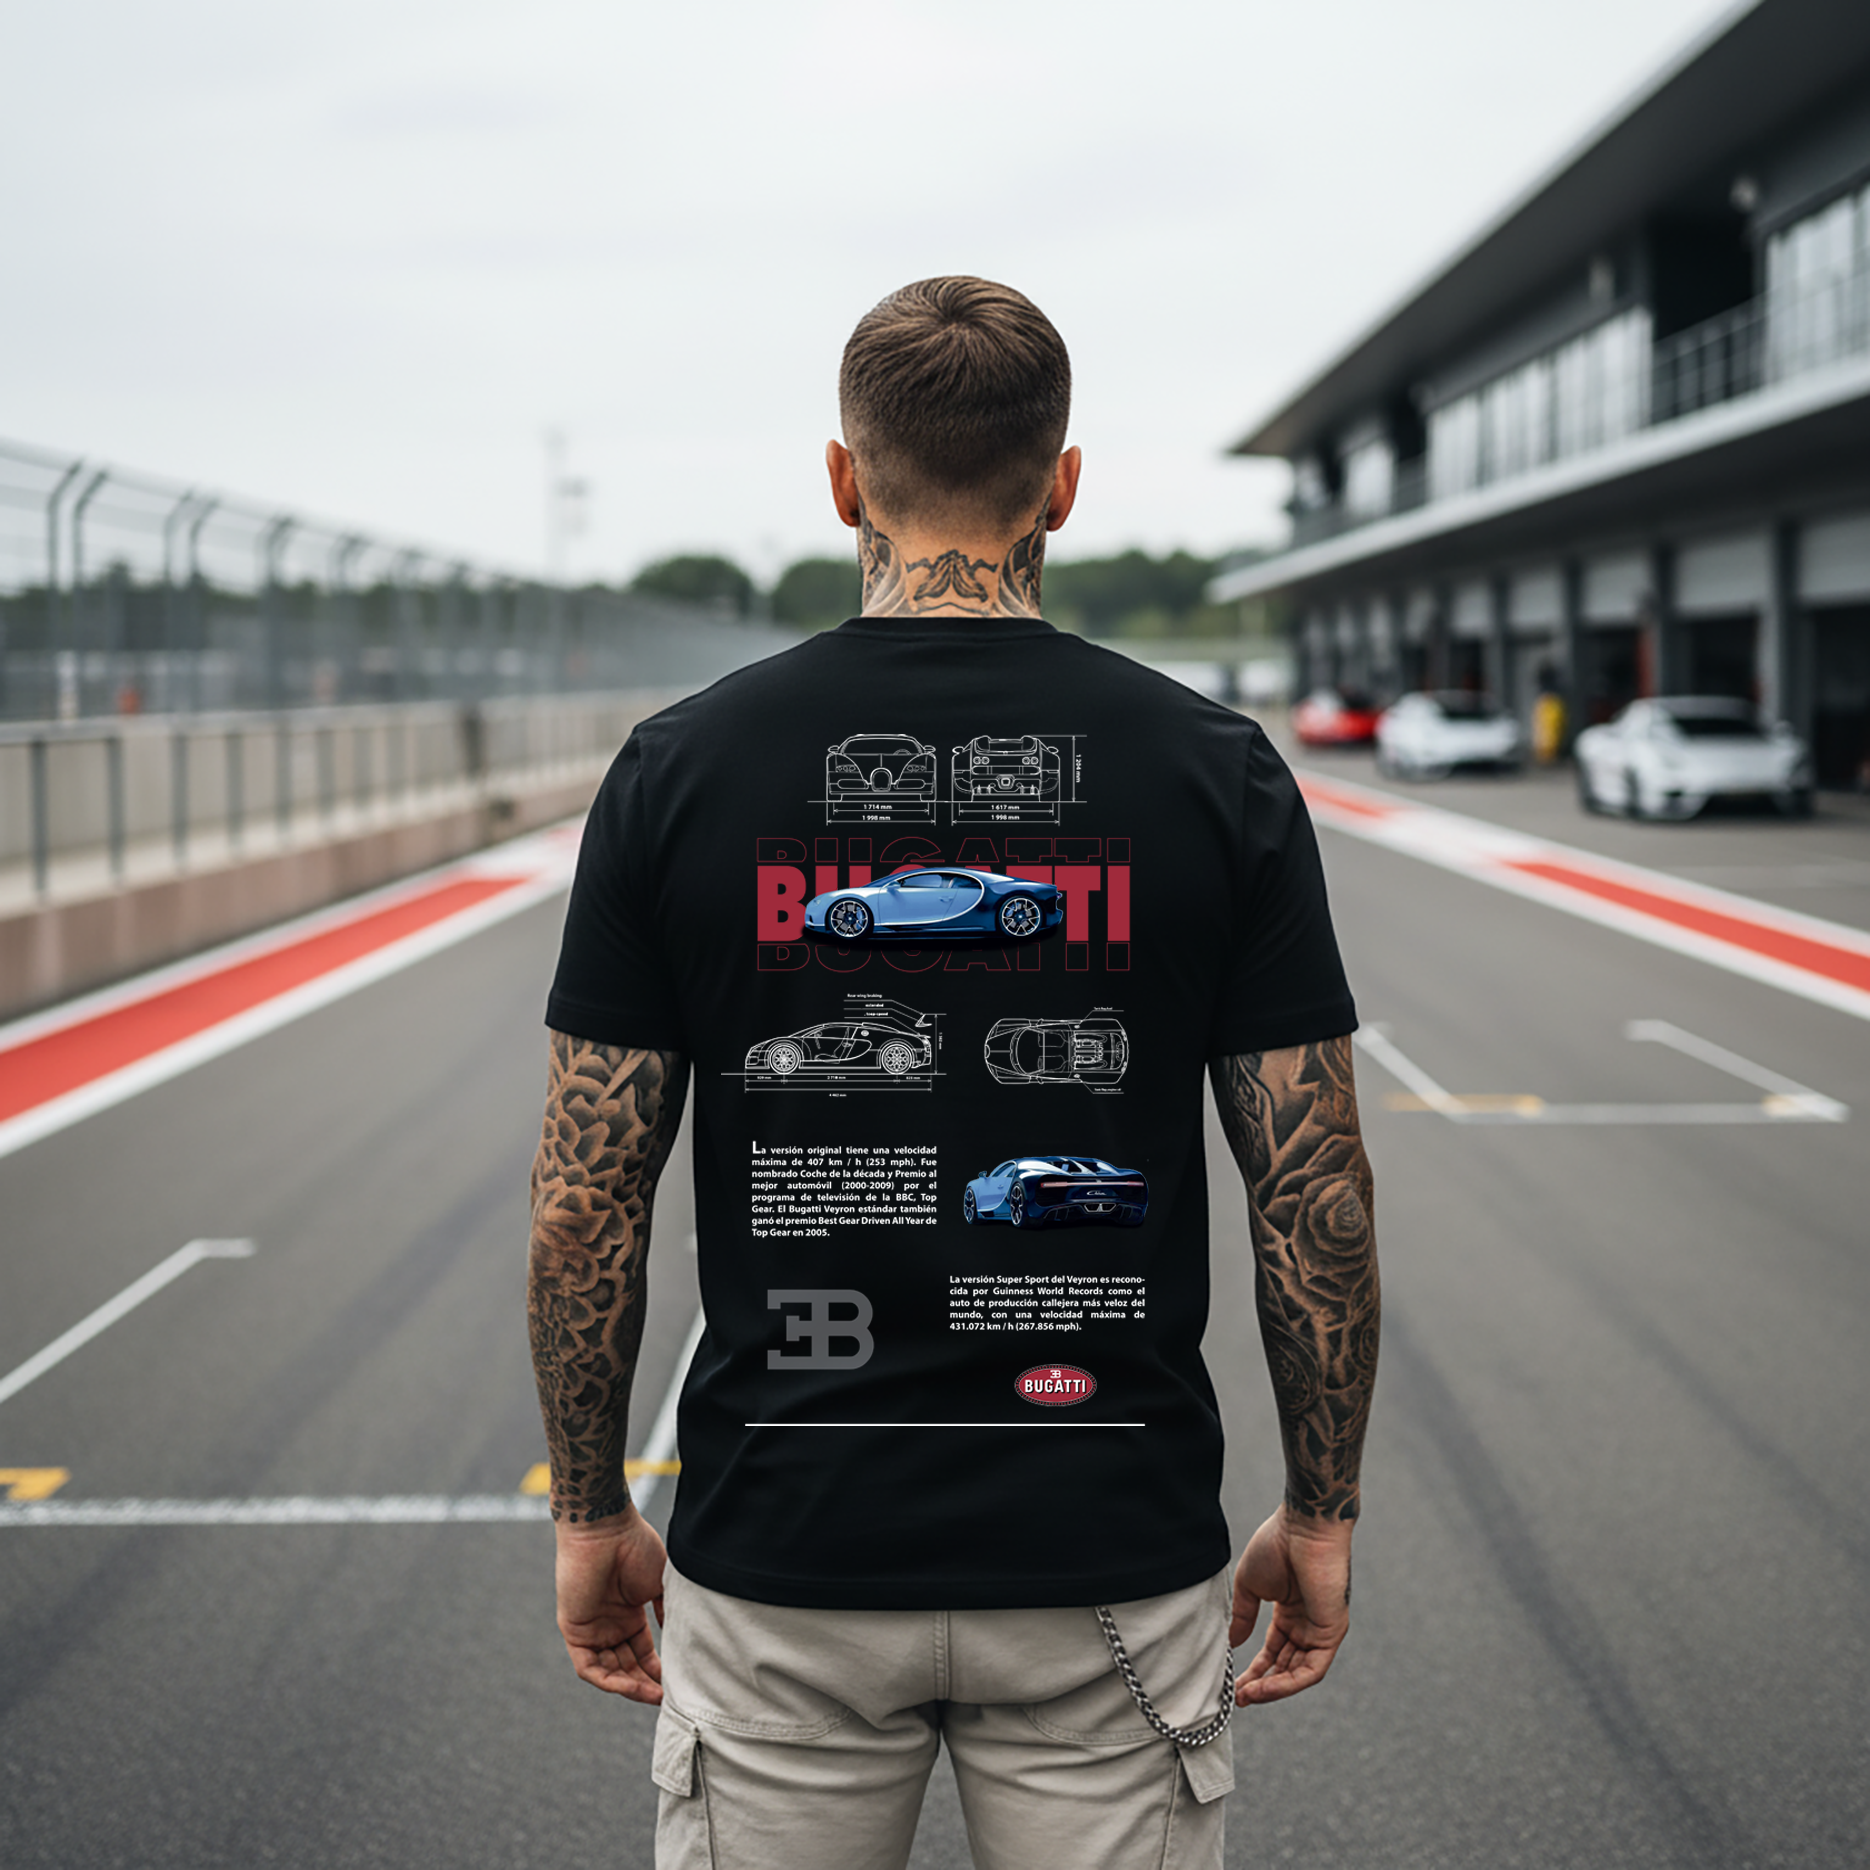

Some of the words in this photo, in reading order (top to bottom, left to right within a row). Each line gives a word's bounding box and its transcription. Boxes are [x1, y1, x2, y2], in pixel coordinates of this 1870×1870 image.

[753, 1141, 766, 1154] La
[771, 1146, 803, 1154] versión
[807, 1146, 841, 1156] original
[846, 1146, 868, 1154] tiene
[894, 1146, 936, 1154] velocidad
[792, 1158, 803, 1166] de
[847, 1158, 851, 1166] /
[866, 1158, 885, 1166] (253
[891, 1158, 916, 1167] mph).
[921, 1158, 937, 1166] Fue
[853, 1169, 885, 1177] década
[752, 1182, 778, 1191] mejor
[787, 1181, 831, 1189] automóvil
[842, 1182, 894, 1190] (2000-2009)
[904, 1183, 919, 1191] por
[929, 1181, 936, 1189] el
[752, 1195, 795, 1203] programa
[801, 1193, 812, 1201] de
[817, 1193, 860, 1201] televisión
[866, 1193, 877, 1201] de
[883, 1193, 890, 1201] la
[896, 1193, 916, 1201] BBC,
[921, 1193, 937, 1203] Top
[752, 1205, 774, 1213] Gear.
[778, 1205, 786, 1213] El
[789, 1205, 821, 1214] Bugatti
[824, 1205, 855, 1214] Veyron
[858, 1205, 897, 1213] estándar
[900, 1205, 937, 1213] también
[752, 1217, 774, 1226] ganó
[785, 1217, 817, 1226] premio
[752, 1228, 768, 1238] Top
[770, 1228, 791, 1236] Gear
[962, 1275, 994, 1283] versión
[997, 1276, 1022, 1285] Super
[1025, 1276, 1049, 1285] Sport
[1051, 1275, 1065, 1283] del
[1067, 1276, 1097, 1285] Veyron
[950, 1287, 968, 1295] cida
[993, 1287, 1033, 1295] Guinness
[1038, 1287, 1063, 1295] World
[1069, 1287, 1103, 1295] Records
[1137, 1287, 1145, 1295] el
[989, 1299, 1038, 1308] producción
[1042, 1299, 1079, 1308] callejera
[950, 1311, 983, 1319] mundo,
[987, 1322, 1000, 1330] km
[1008, 1322, 1014, 1330] h
[1016, 1323, 1054, 1331] (267.856
[1056, 1322, 1081, 1332] mph).
[1024, 1379, 1087, 1393] BUGATTI
